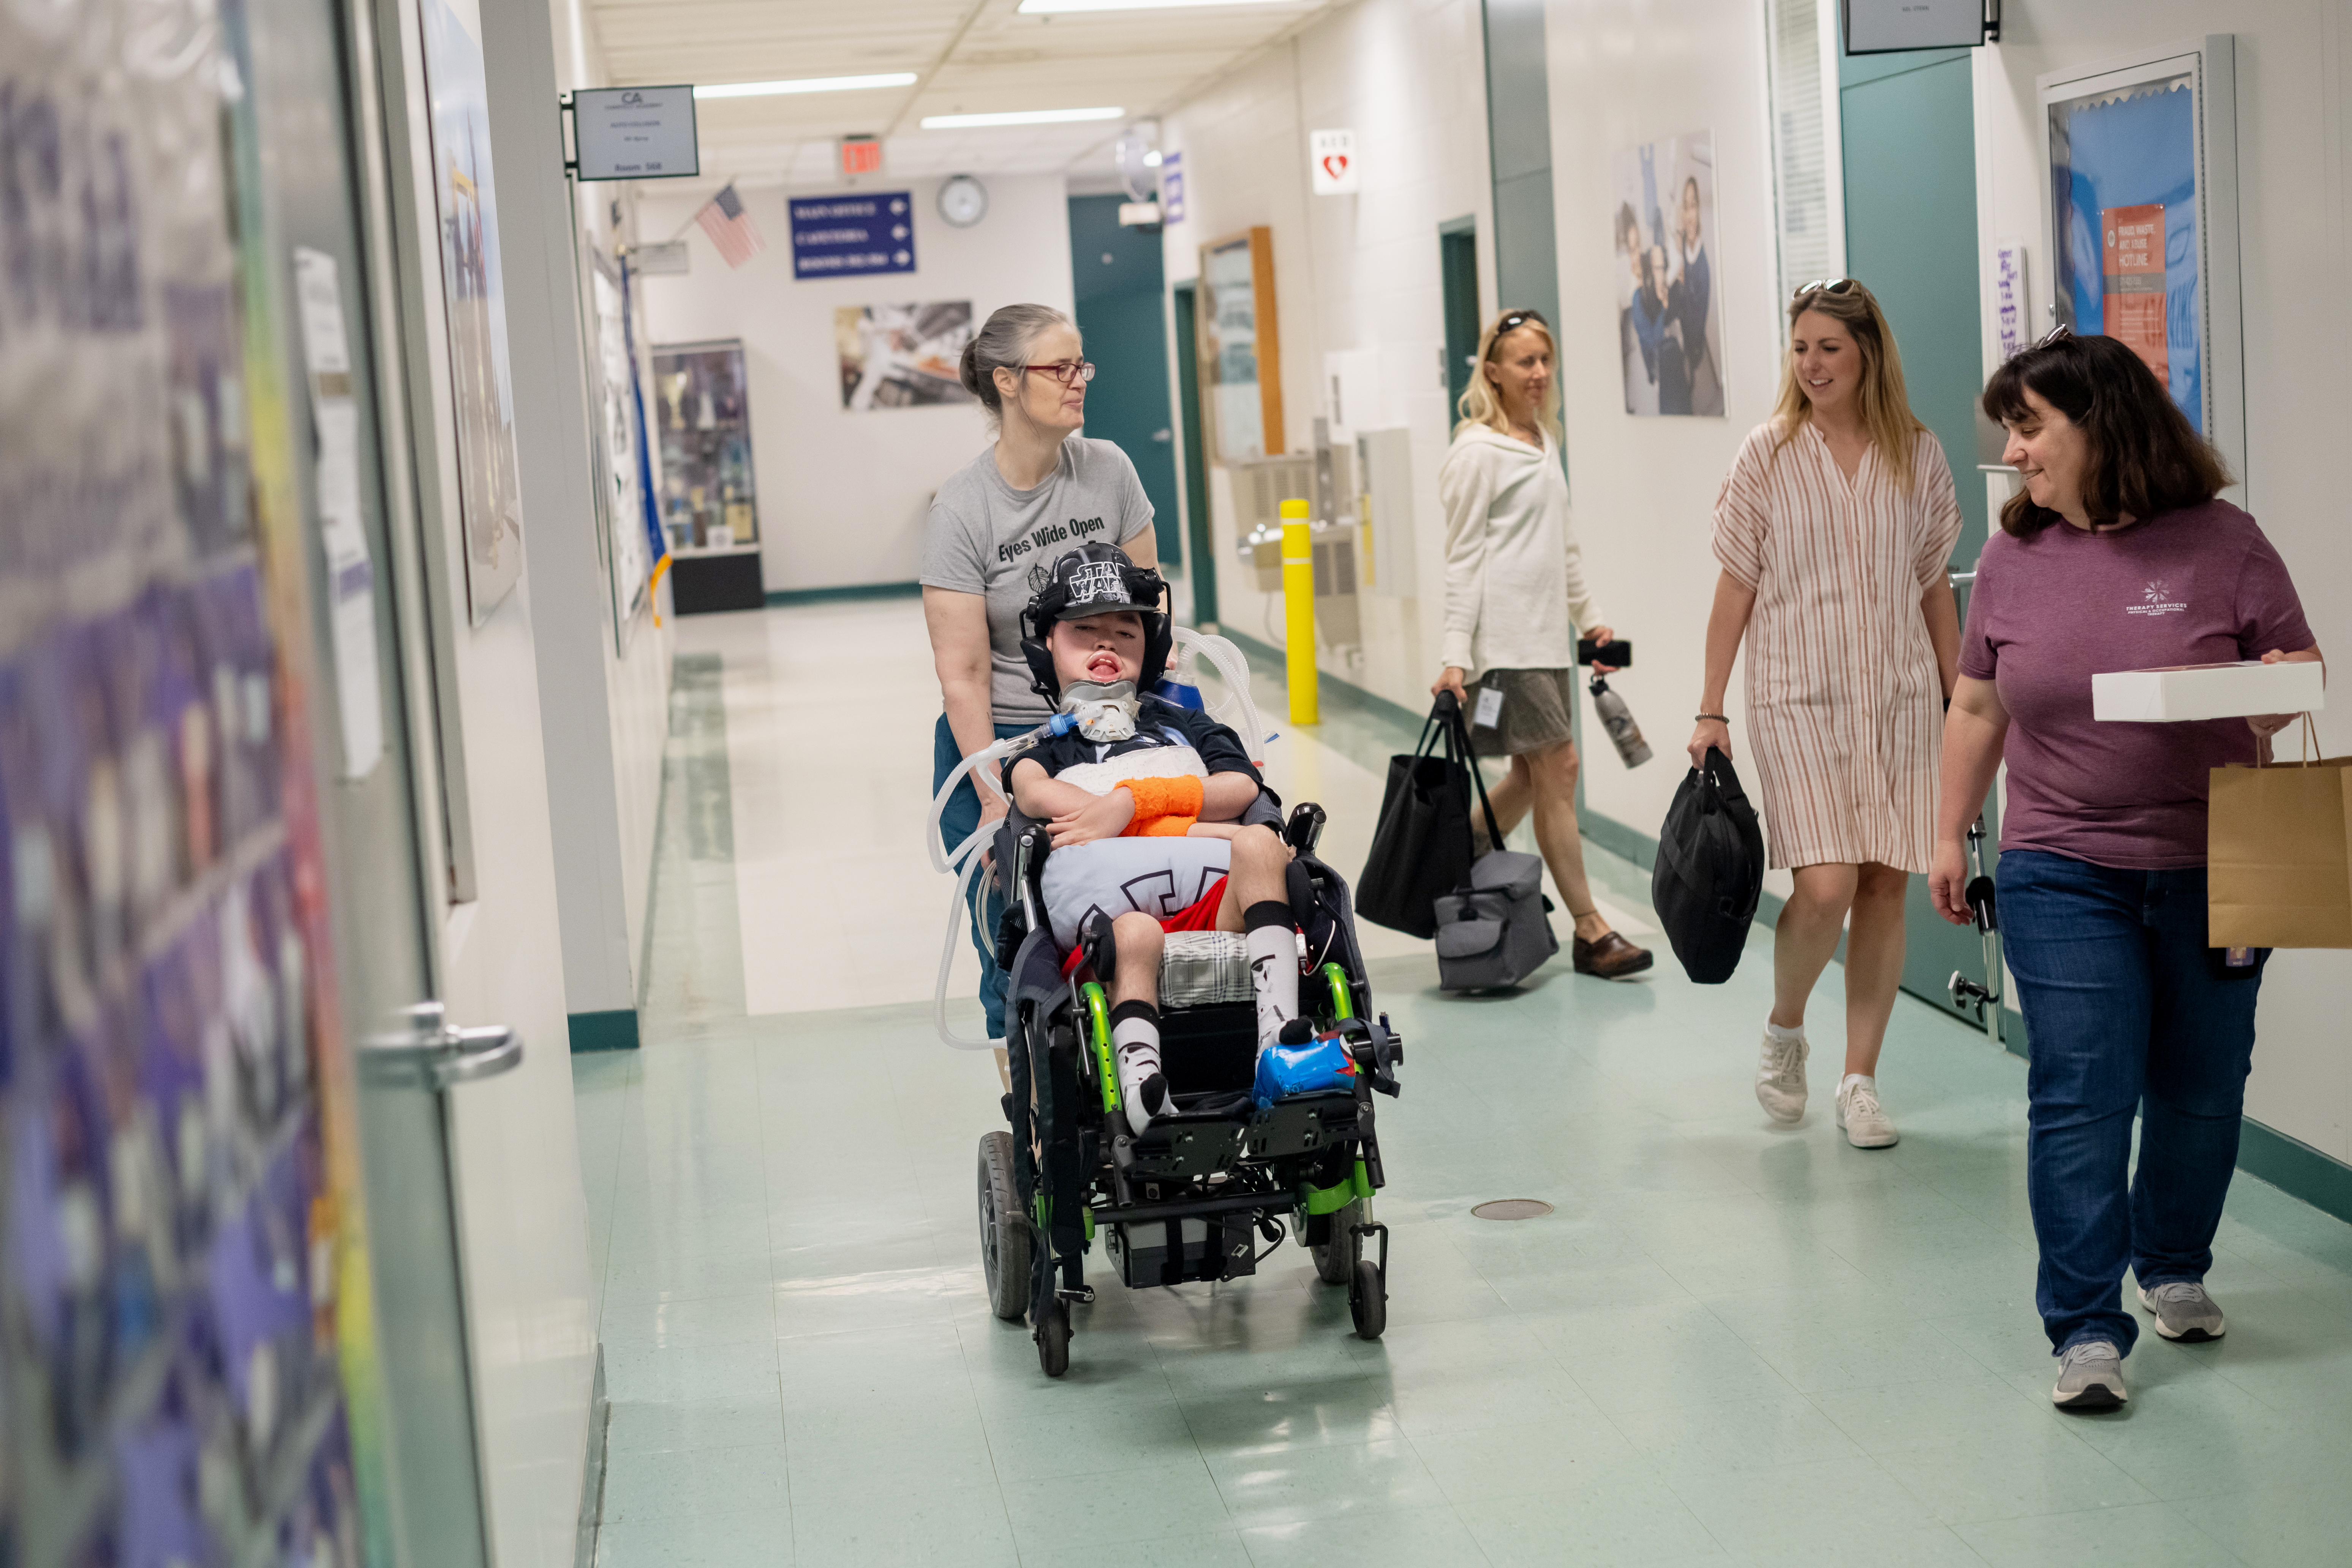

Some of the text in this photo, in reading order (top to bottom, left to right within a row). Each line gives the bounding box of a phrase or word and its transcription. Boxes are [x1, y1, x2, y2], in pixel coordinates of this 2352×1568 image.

[622, 92, 643, 104] CA
[2120, 238, 2147, 250] AND ABUSE
[2119, 253, 2148, 267] HOTLINE
[999, 517, 1105, 563] Eyes Wide Open
[1070, 576, 1131, 598] WAR
